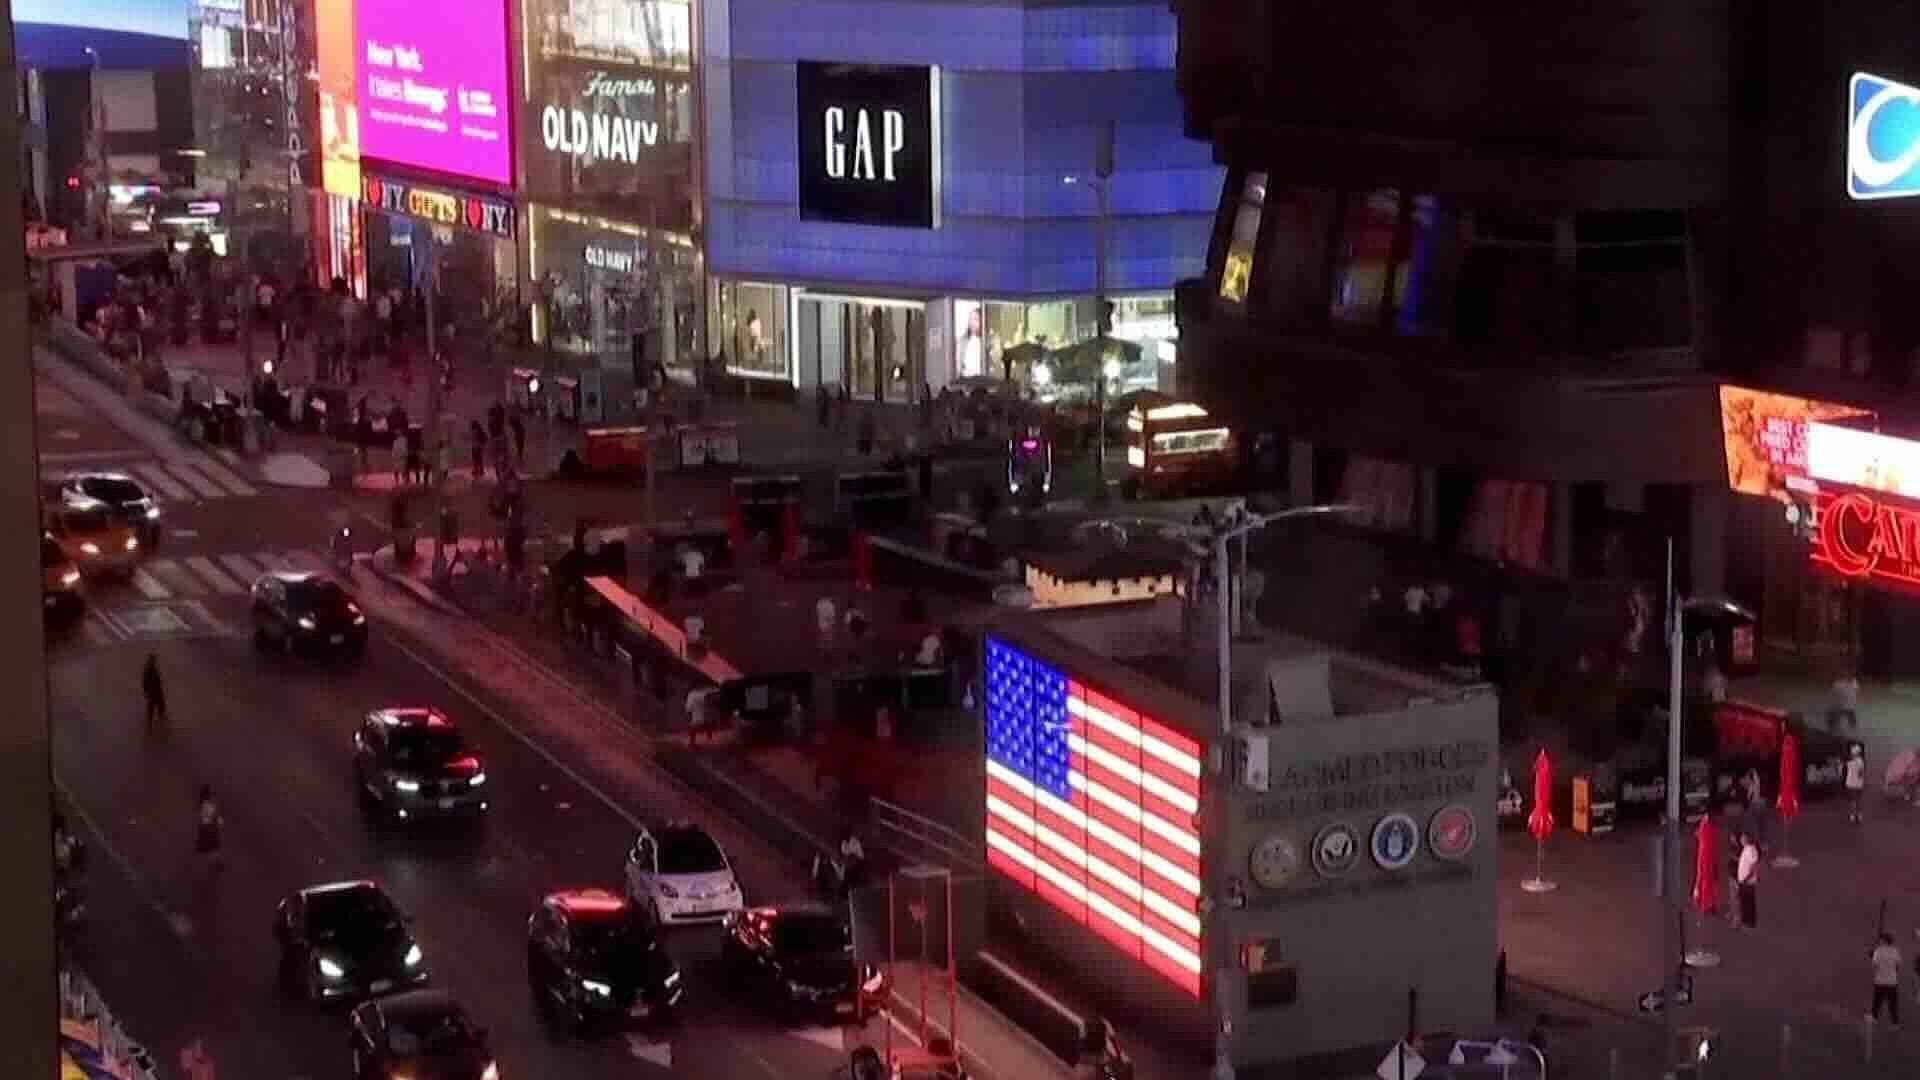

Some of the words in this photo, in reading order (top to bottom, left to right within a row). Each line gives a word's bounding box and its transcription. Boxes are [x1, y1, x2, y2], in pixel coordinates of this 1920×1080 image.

[543, 105, 588, 154] OLD
[825, 106, 904, 181] GAP
[409, 189, 457, 223] GIFTS
